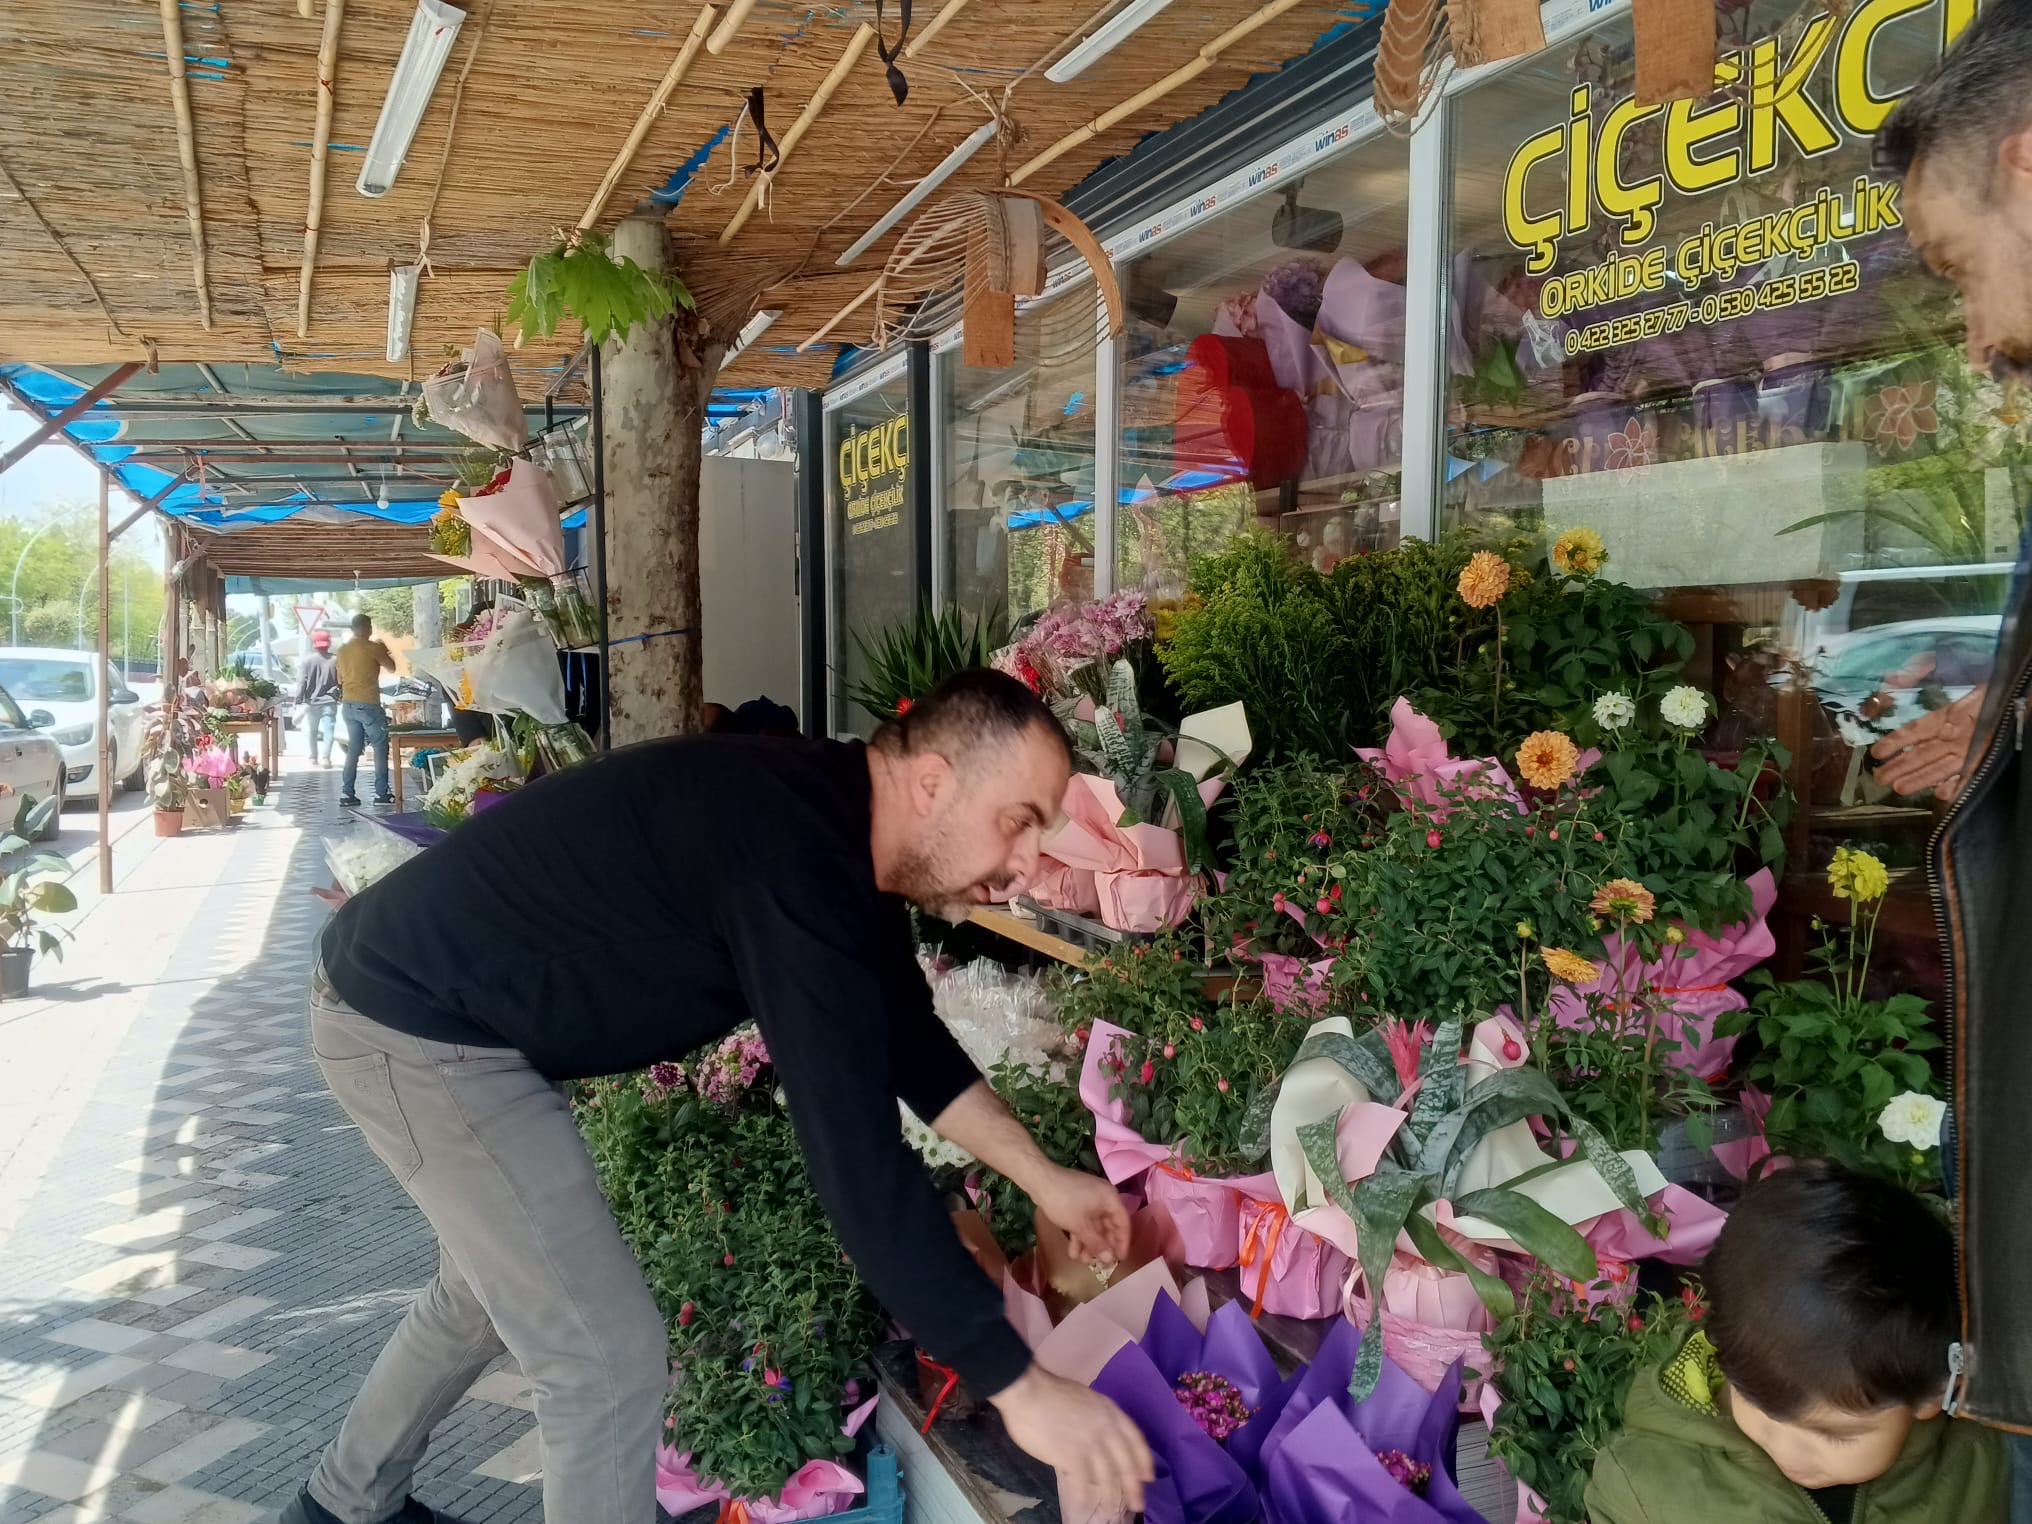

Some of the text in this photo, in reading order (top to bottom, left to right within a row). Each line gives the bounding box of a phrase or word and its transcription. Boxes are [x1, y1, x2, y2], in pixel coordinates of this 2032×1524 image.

[1315, 125, 1349, 152] winas
[1249, 163, 1278, 187] winas
[1190, 195, 1216, 218] winas
[1138, 223, 1162, 243] winas
[1540, 175, 1903, 318] ORKİDE ÇİÇEKÇİLİK
[1565, 329, 1580, 355] 0
[1580, 321, 1611, 352] 422
[1611, 313, 1643, 345] 325
[1643, 306, 1666, 338] 27
[1665, 302, 1692, 333] 77
[1701, 295, 1717, 325] 0
[1717, 285, 1756, 321] 530
[1756, 276, 1797, 311] 425
[1798, 267, 1828, 303] 55
[1827, 258, 1860, 296] 22
